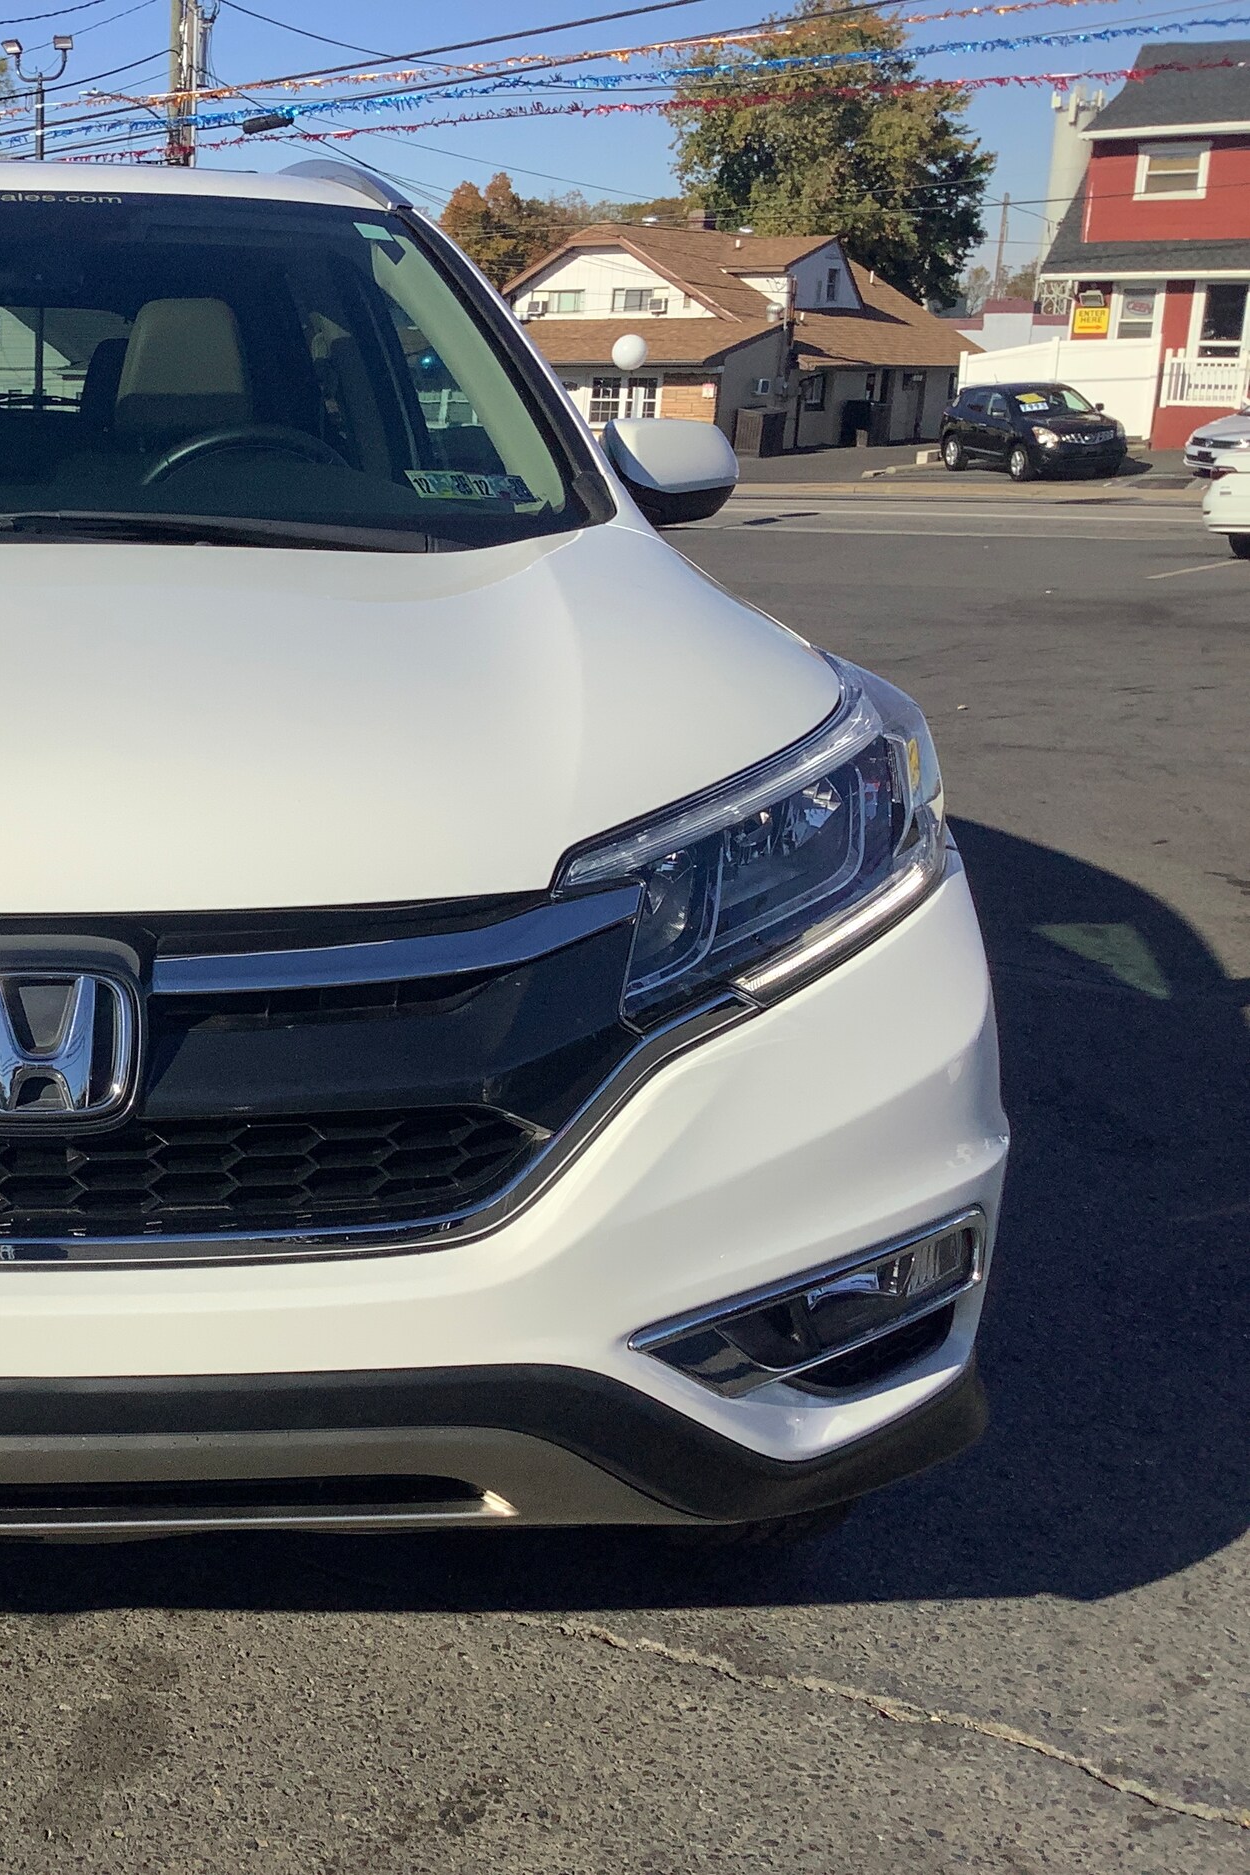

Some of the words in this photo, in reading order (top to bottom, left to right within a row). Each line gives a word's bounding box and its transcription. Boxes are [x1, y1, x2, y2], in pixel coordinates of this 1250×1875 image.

[1078, 309, 1106, 317] ENTER
[413, 477, 435, 494] 12
[473, 480, 494, 496] 12
